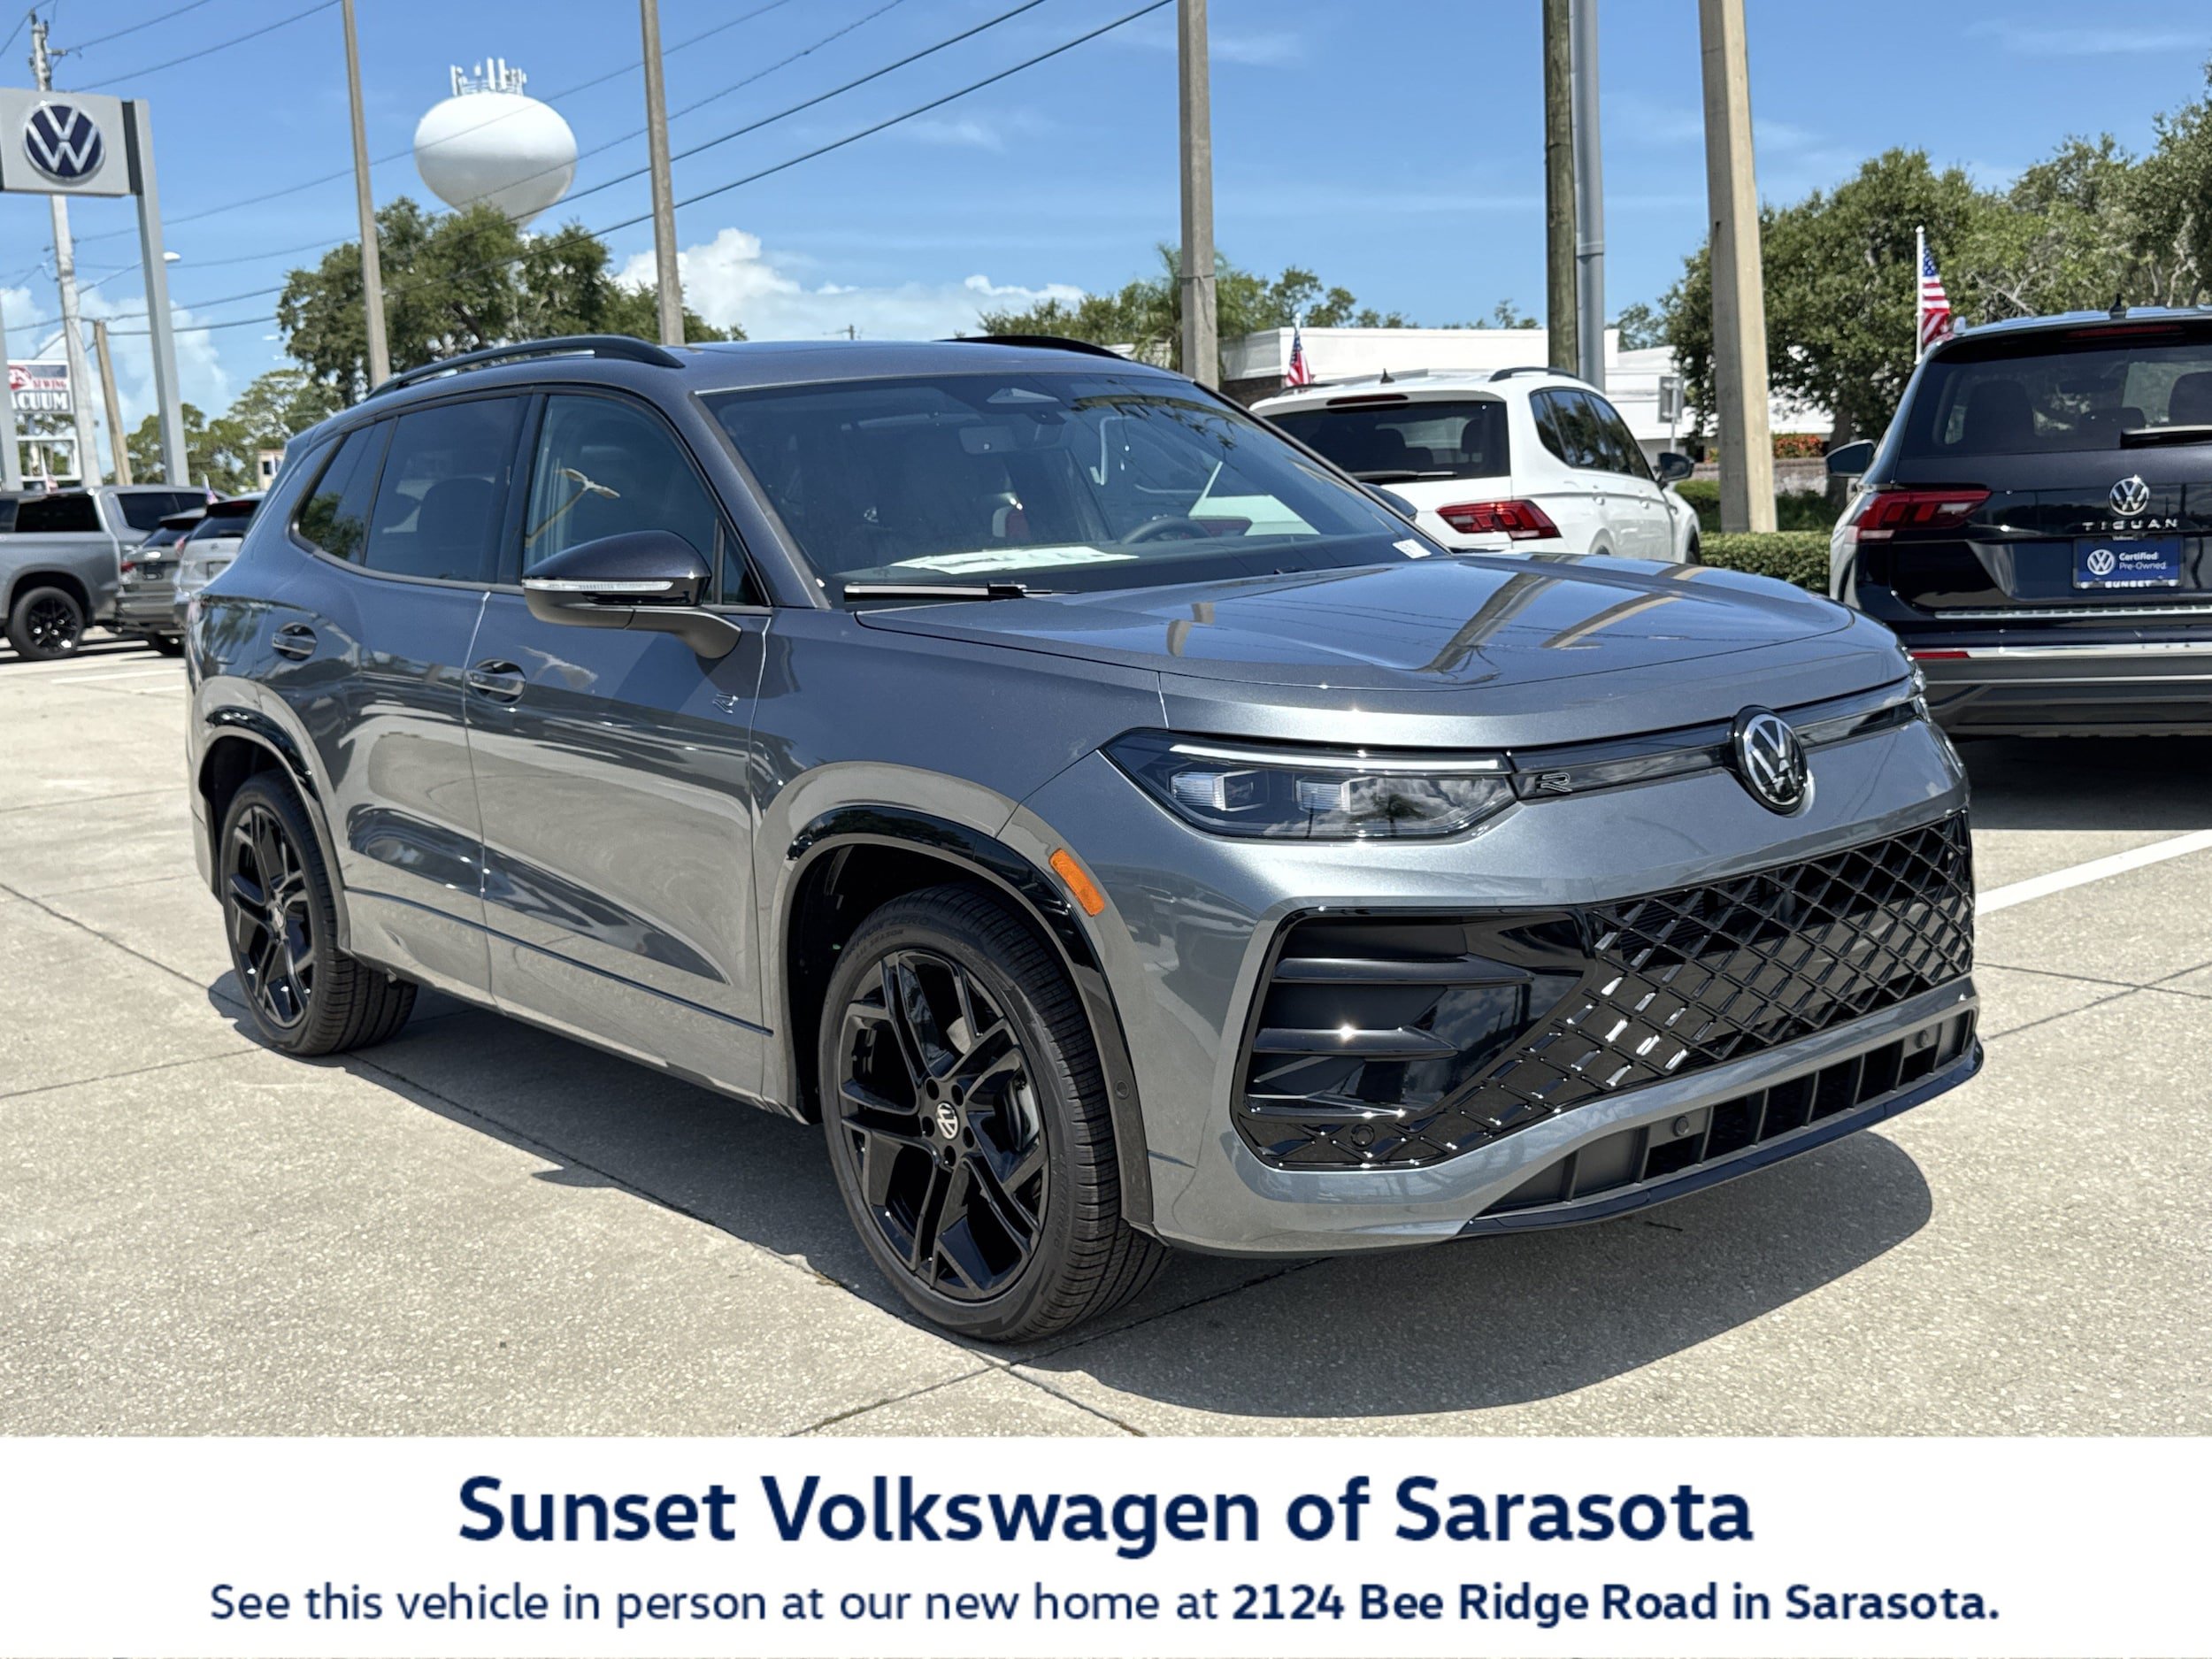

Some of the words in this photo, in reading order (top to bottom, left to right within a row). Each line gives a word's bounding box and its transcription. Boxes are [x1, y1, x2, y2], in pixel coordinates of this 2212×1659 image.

[2082, 518, 2177, 531] TIGUAN
[2119, 552, 2159, 561] Certified
[2104, 580, 2153, 588] SUNSET
